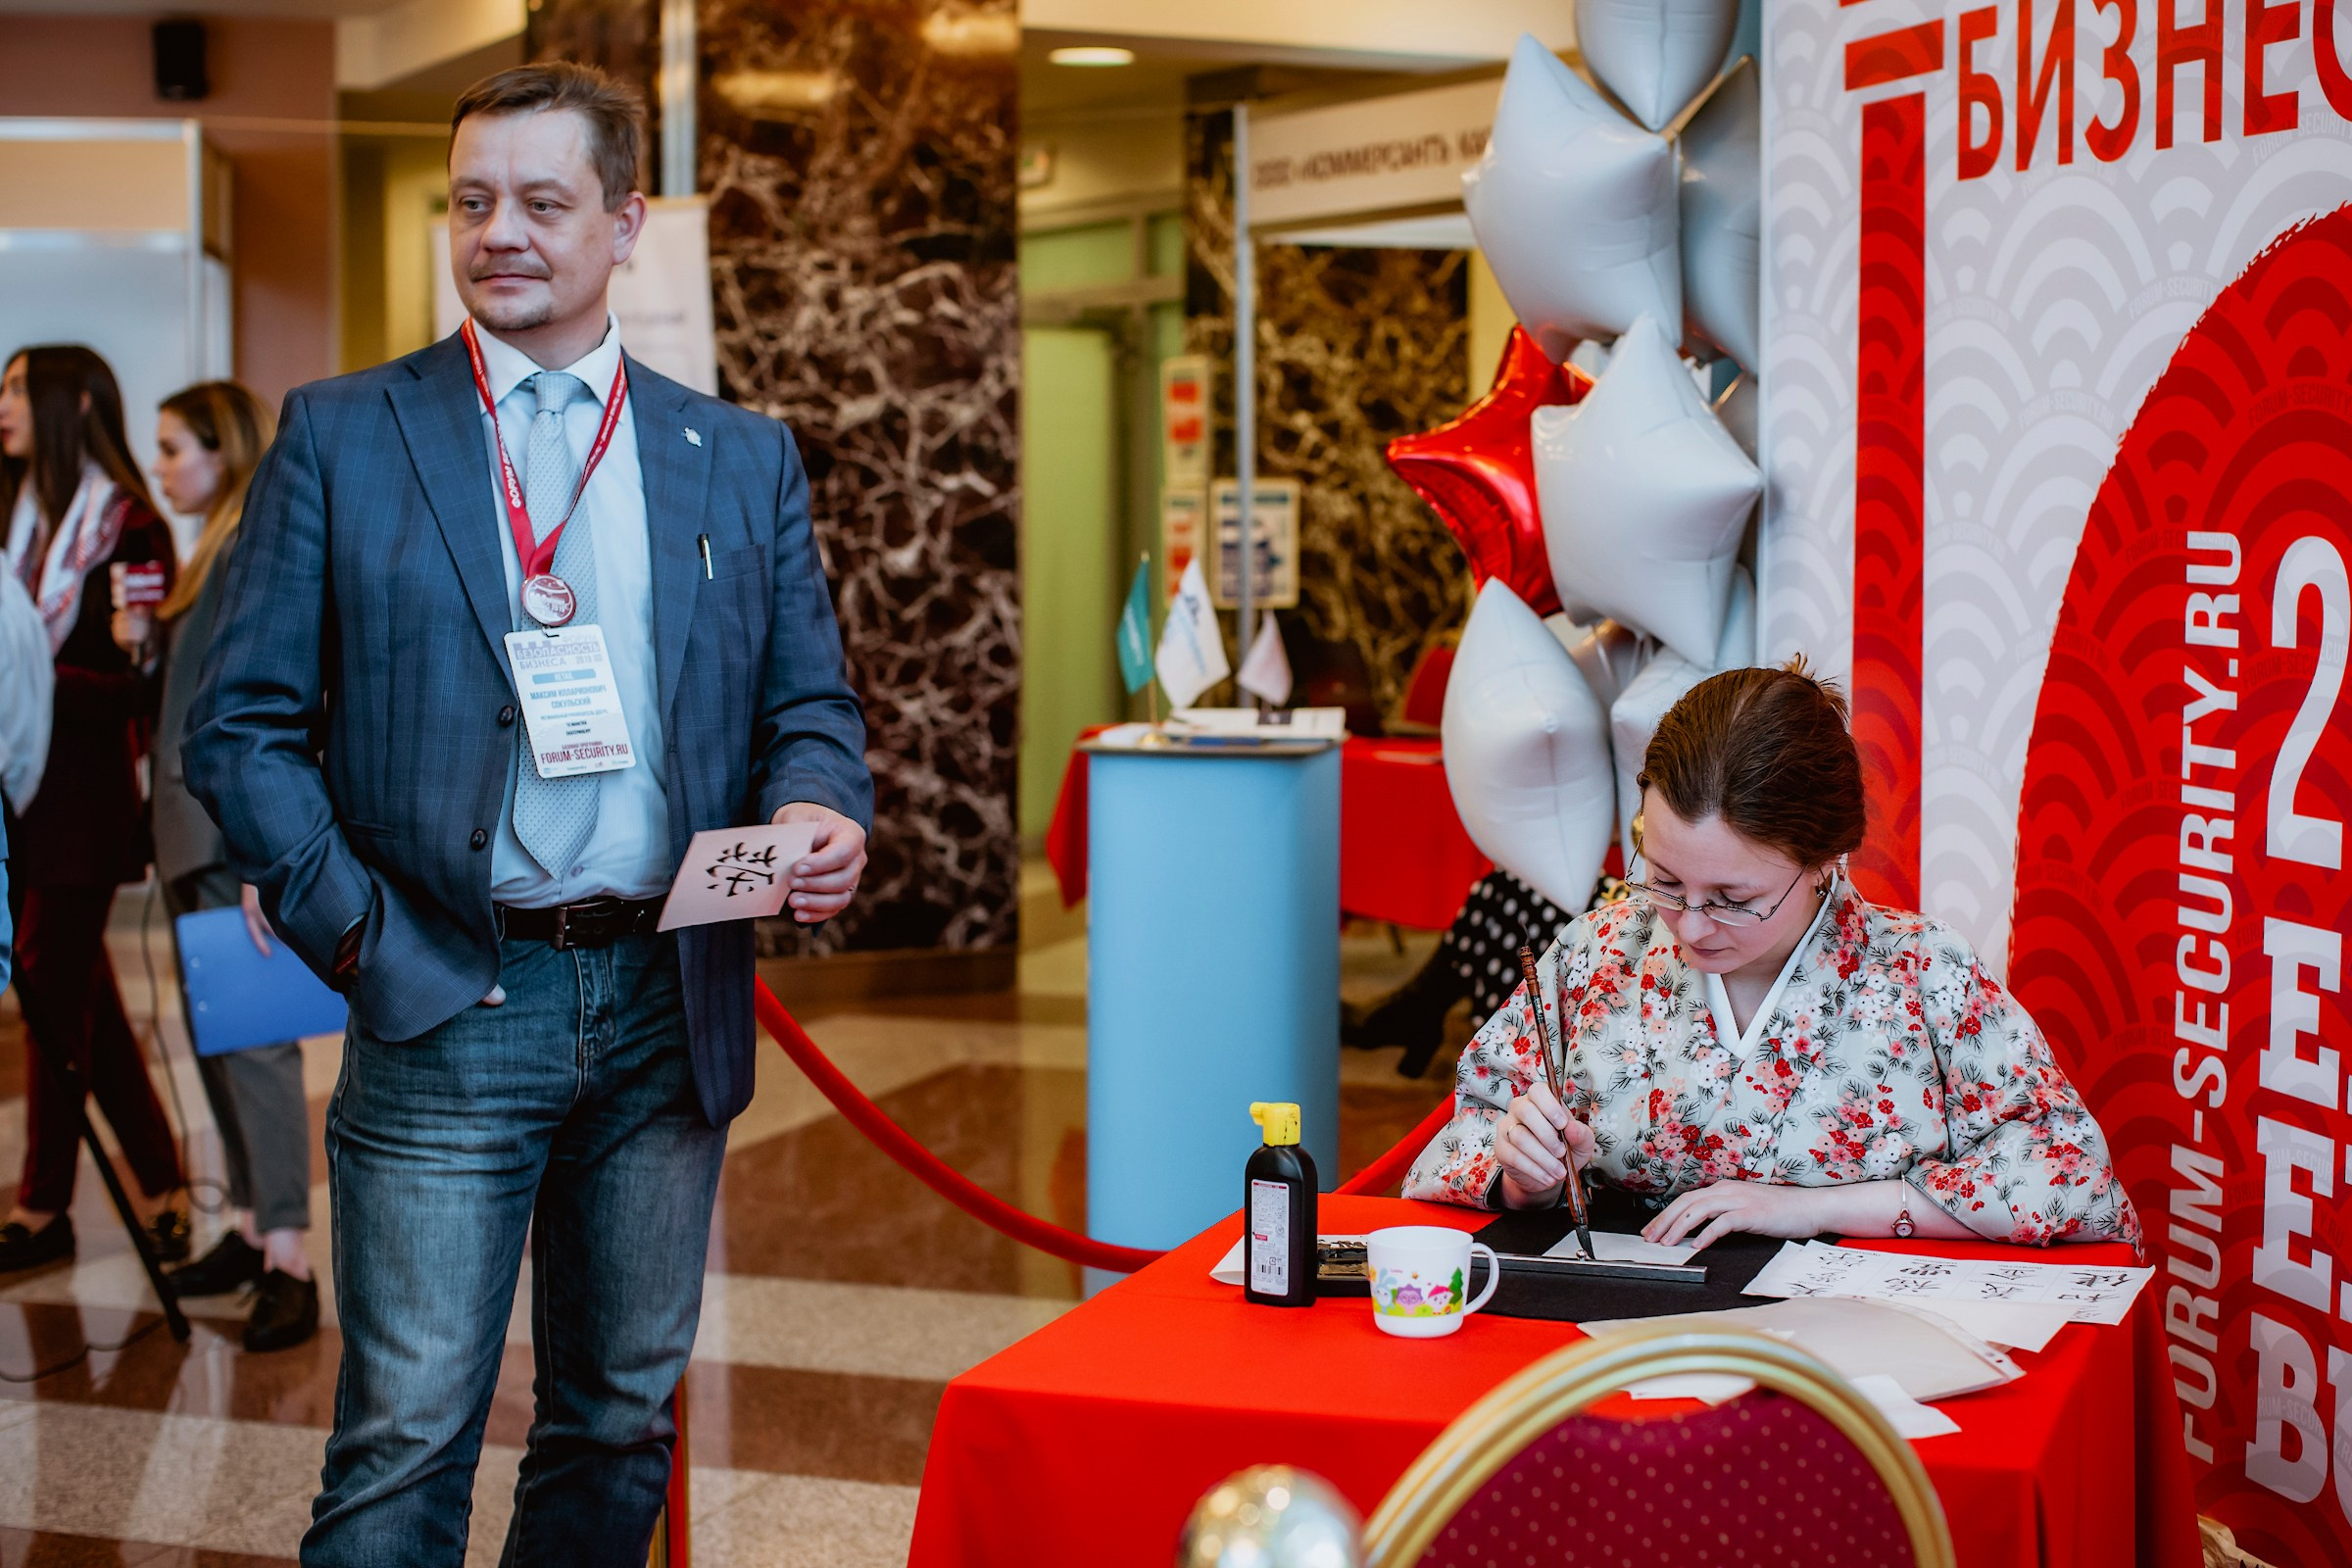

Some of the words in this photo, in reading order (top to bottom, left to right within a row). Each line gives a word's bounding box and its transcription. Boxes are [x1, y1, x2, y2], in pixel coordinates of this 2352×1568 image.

[515, 642, 600, 661] БЕЗОПАСНОСТЬ
[519, 657, 566, 670] БИЗНЕСА
[530, 689, 557, 701] МАКСИМ
[540, 744, 628, 764] FORUM-SECURITY.RU
